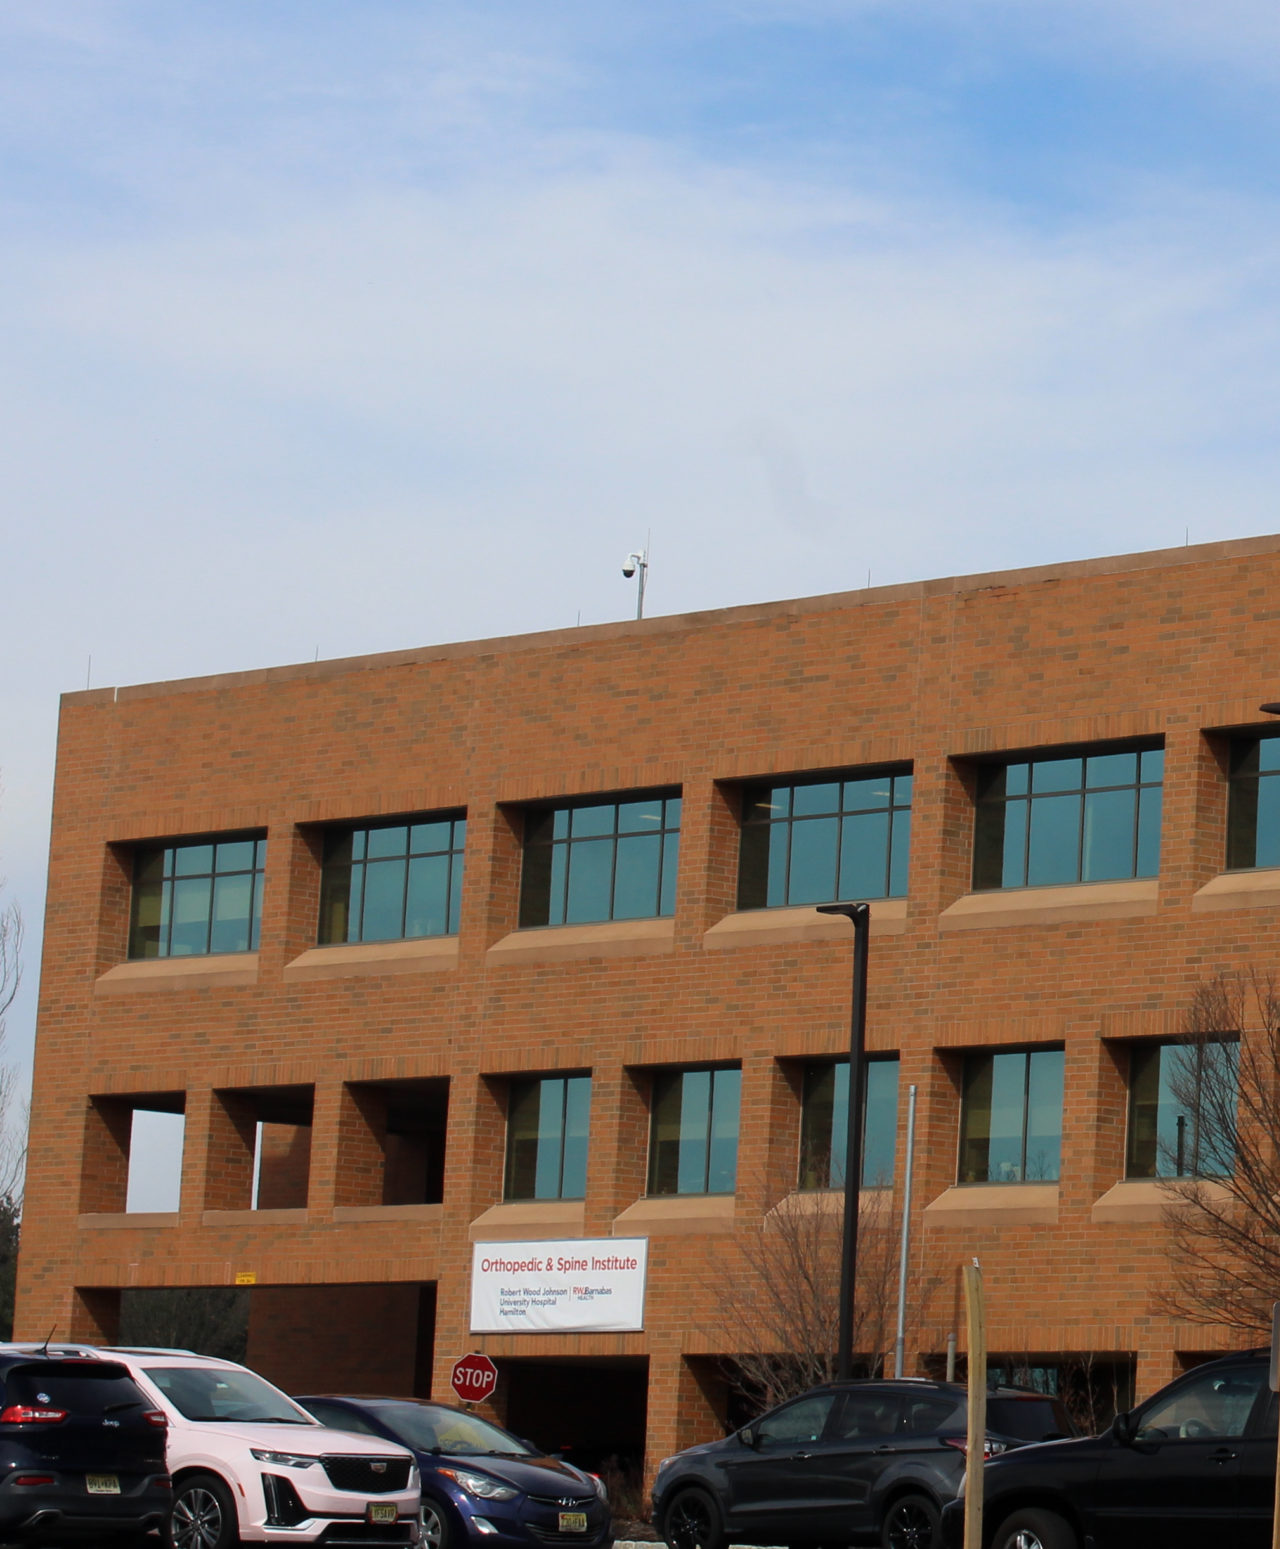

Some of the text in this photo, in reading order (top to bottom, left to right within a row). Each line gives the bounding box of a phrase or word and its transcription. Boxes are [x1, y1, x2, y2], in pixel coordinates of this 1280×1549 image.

[481, 1255, 638, 1275] Orthopedic & Spine Institute
[500, 1287, 568, 1296] Robert Wood Johnson
[499, 1297, 557, 1309] University Hospital
[499, 1308, 527, 1316] Hamilton
[454, 1367, 493, 1389] STOP
